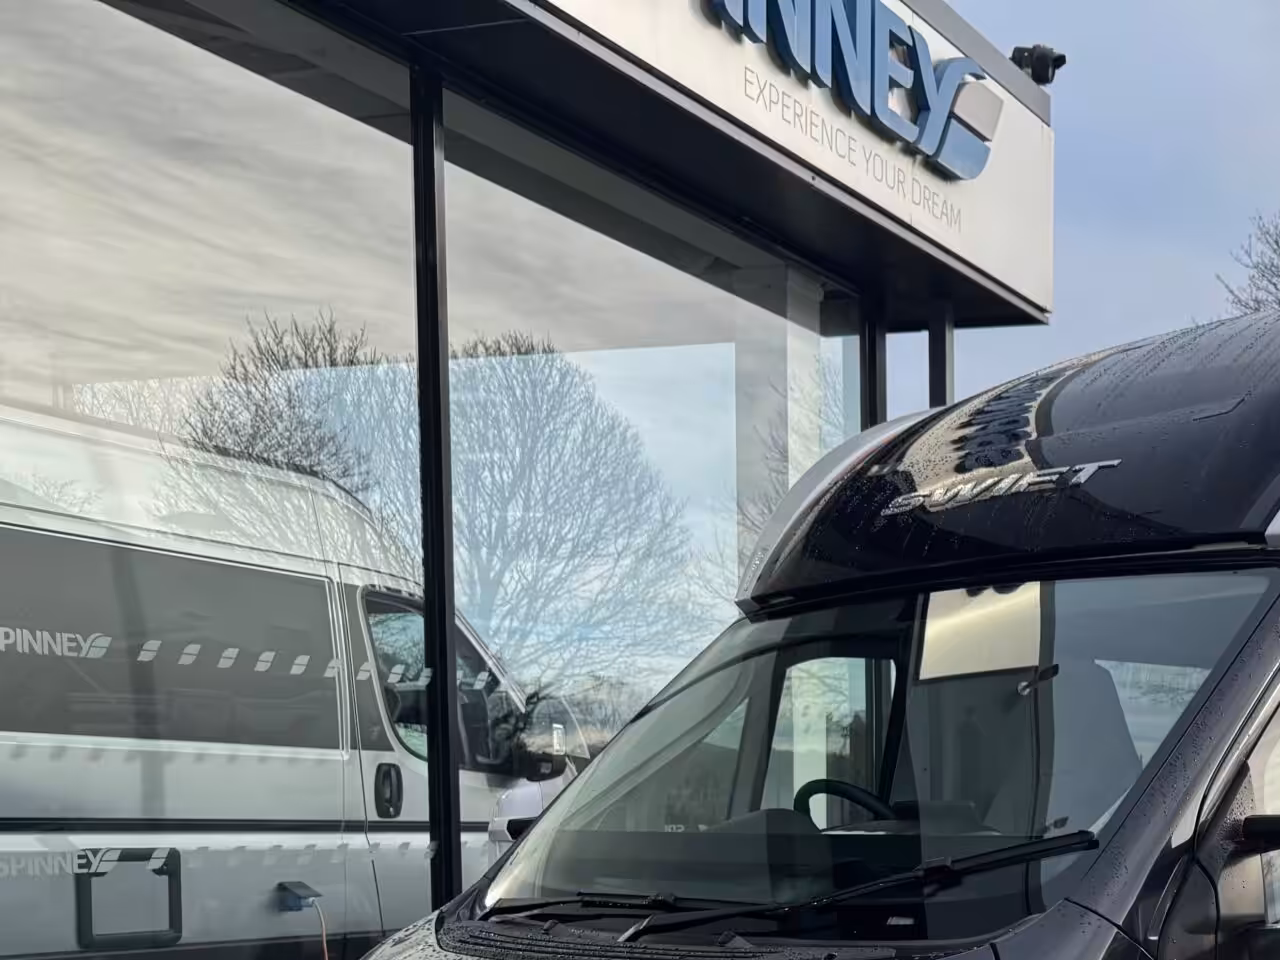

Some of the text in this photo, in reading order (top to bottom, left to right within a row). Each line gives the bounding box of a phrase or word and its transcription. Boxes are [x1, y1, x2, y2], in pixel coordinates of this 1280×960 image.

[743, 65, 963, 234] EXPERIENCE YOUR DREAM
